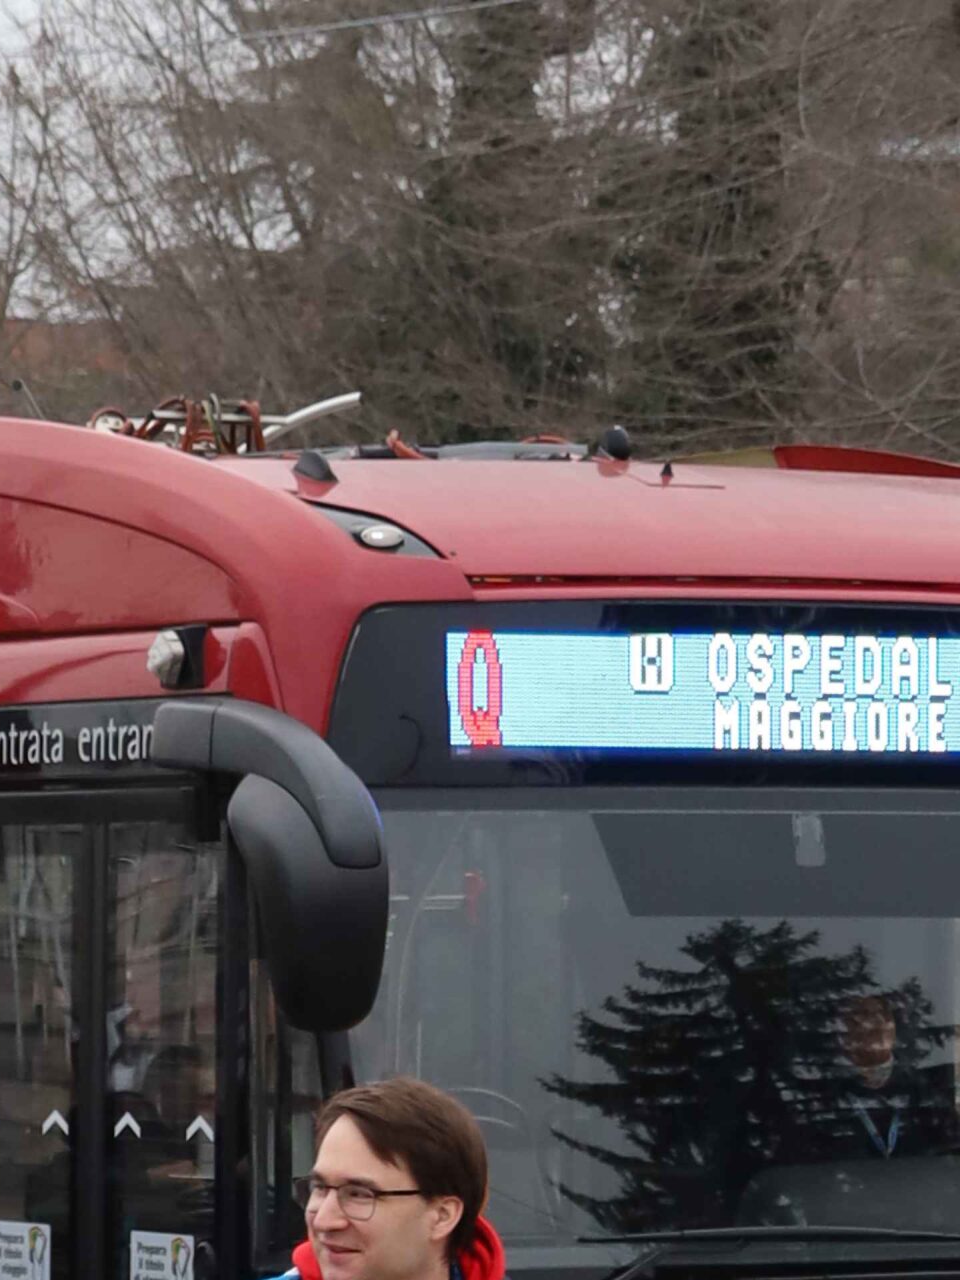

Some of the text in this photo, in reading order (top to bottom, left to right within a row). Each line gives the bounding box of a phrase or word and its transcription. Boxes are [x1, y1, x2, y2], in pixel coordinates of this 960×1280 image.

[708, 633, 953, 697] OSPEDAL
[77, 717, 154, 763] entran
[714, 699, 948, 753] MAGGIORE
